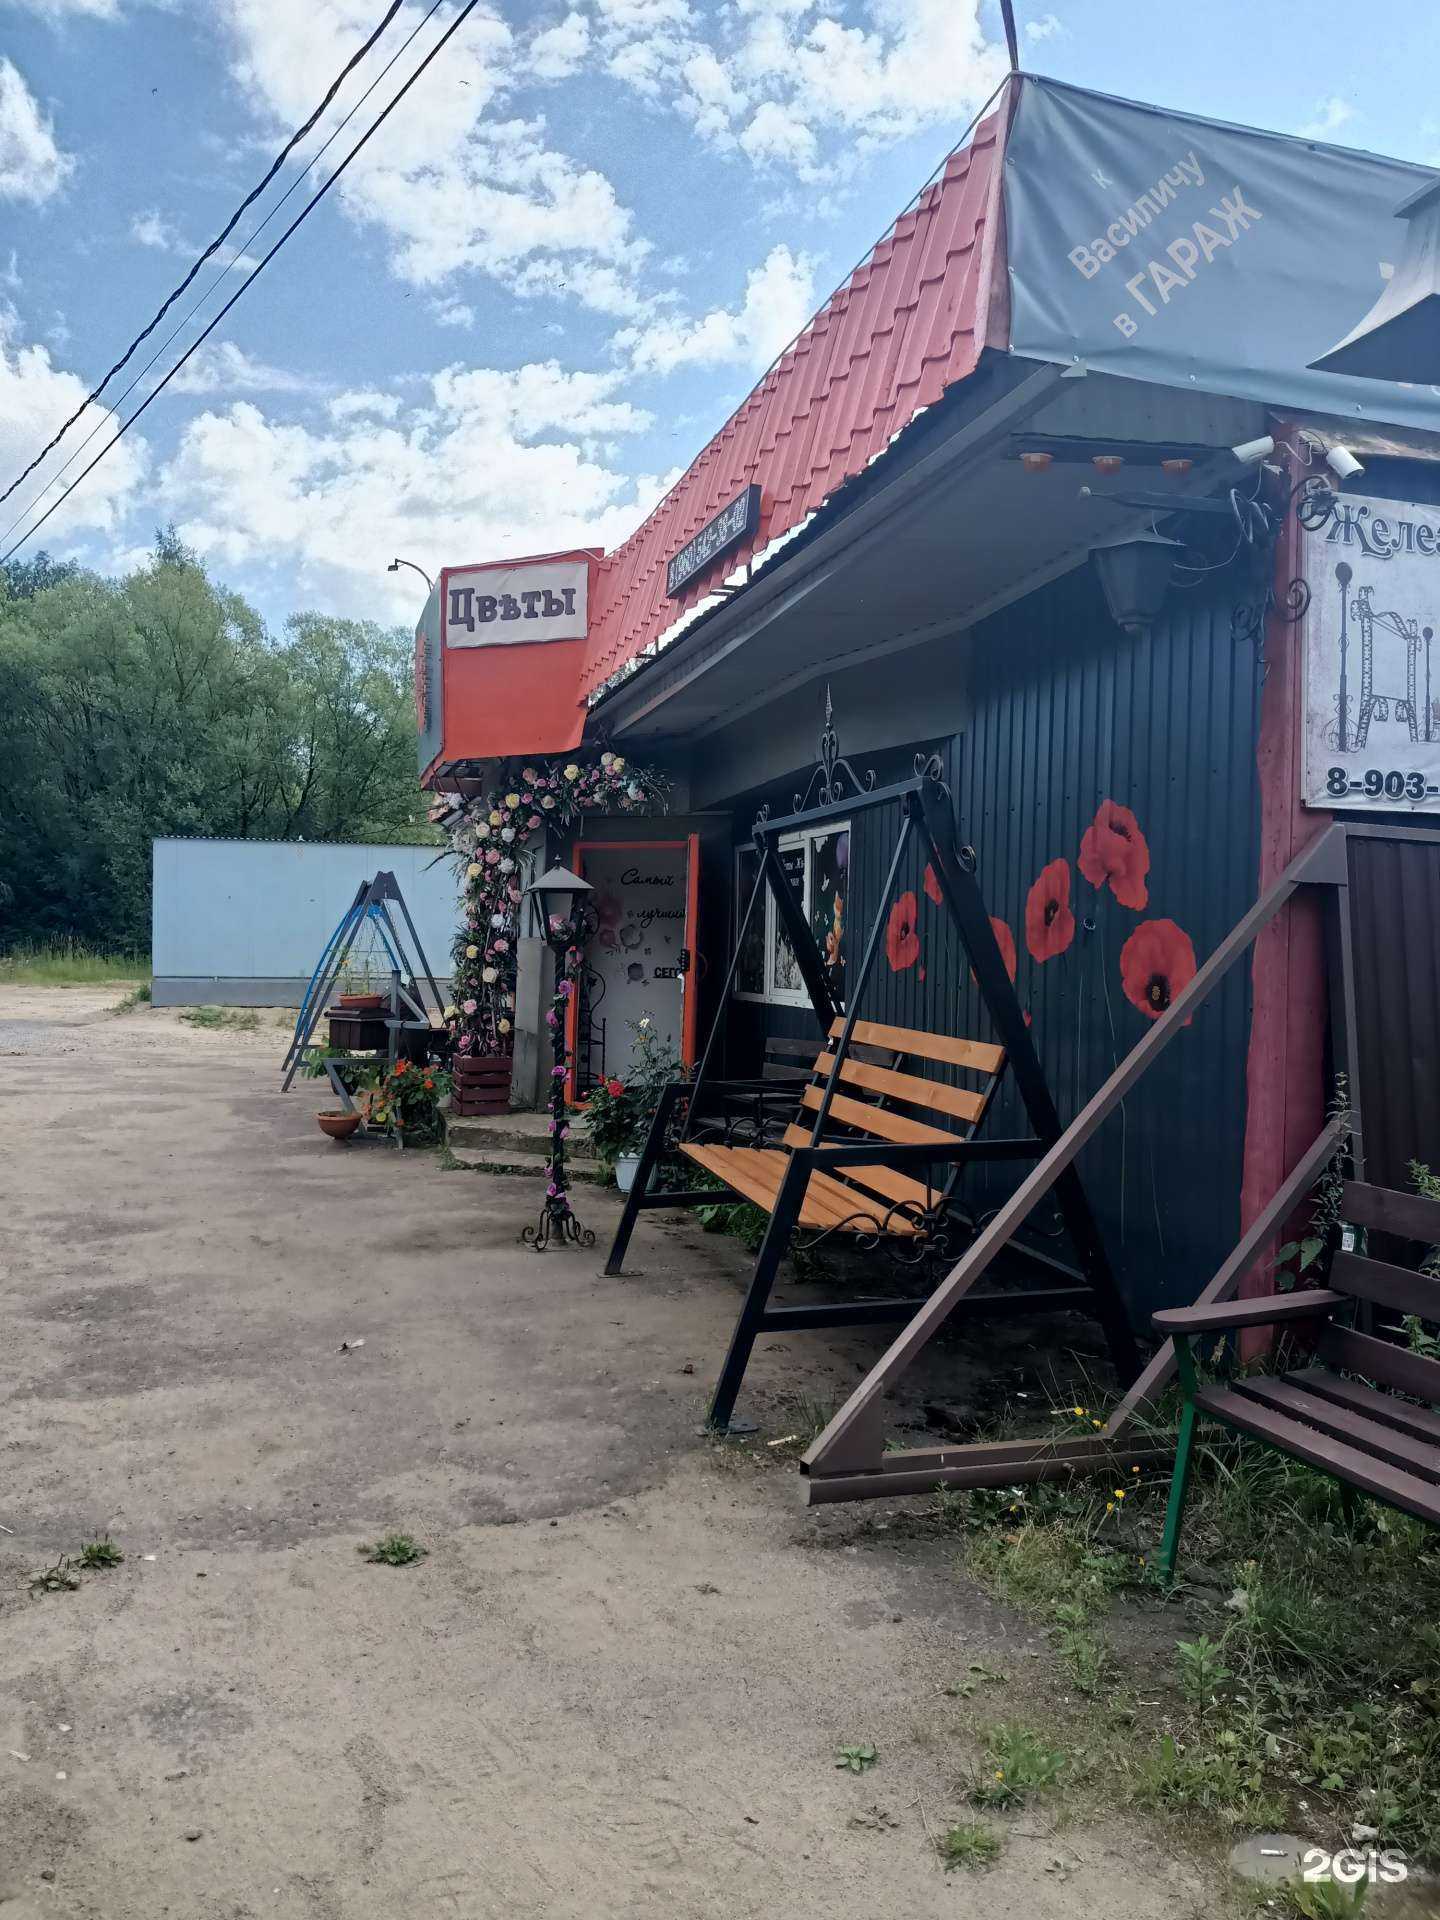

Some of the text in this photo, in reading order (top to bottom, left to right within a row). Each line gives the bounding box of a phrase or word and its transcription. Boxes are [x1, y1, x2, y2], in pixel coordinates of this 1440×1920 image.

[1067, 151, 1205, 280] Василичу
[1125, 185, 1263, 317] ГАРАЖ
[620, 868, 674, 886] Самый
